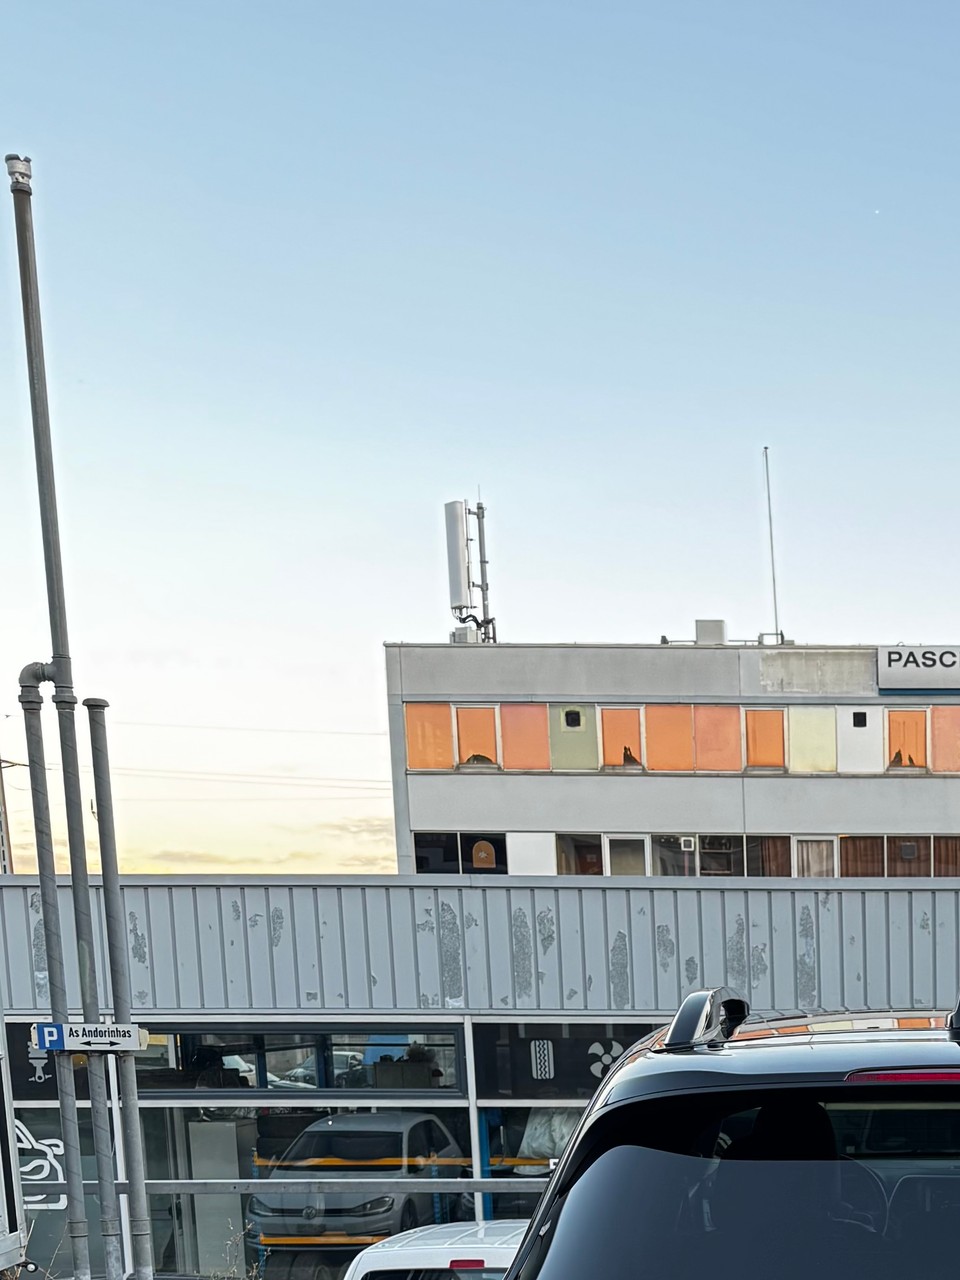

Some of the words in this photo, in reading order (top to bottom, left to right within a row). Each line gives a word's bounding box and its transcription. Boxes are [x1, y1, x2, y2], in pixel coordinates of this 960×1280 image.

[43, 1027, 58, 1048] P
[68, 1027, 80, 1038] As
[81, 1027, 132, 1039] Andorinhas
